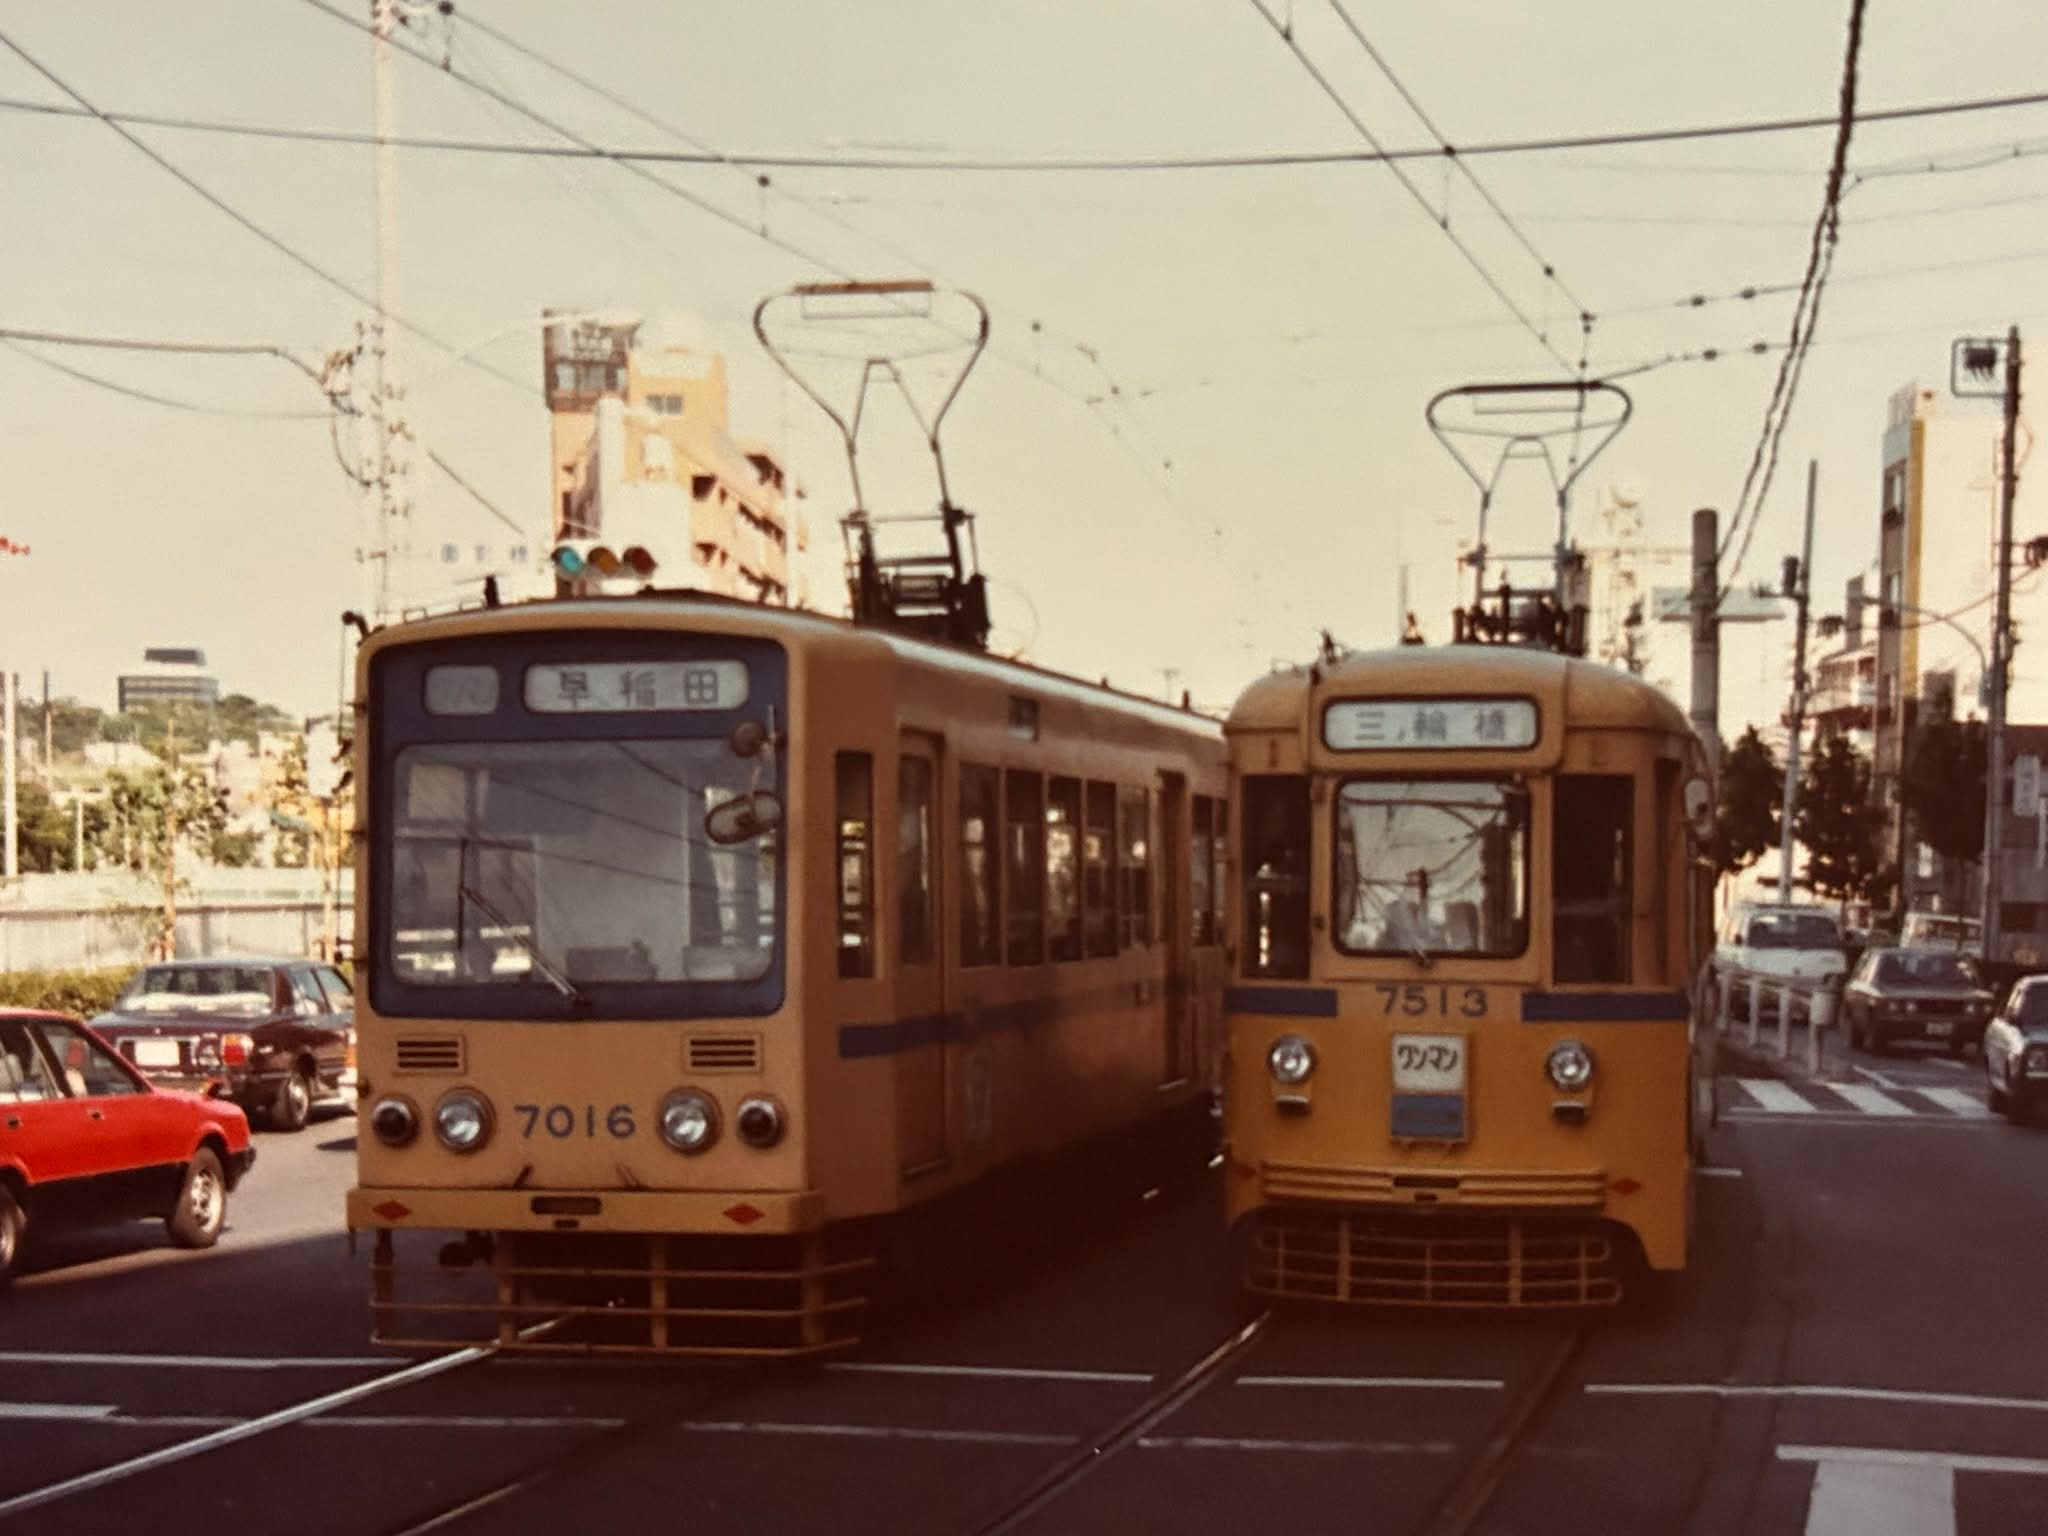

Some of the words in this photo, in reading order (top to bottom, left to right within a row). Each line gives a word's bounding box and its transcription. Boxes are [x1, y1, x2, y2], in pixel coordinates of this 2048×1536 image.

[557, 669, 718, 708] 早稲田
[1377, 986, 1489, 1018] 7513
[1396, 1045, 1458, 1072] ワンマン
[514, 1104, 637, 1140] 7016
